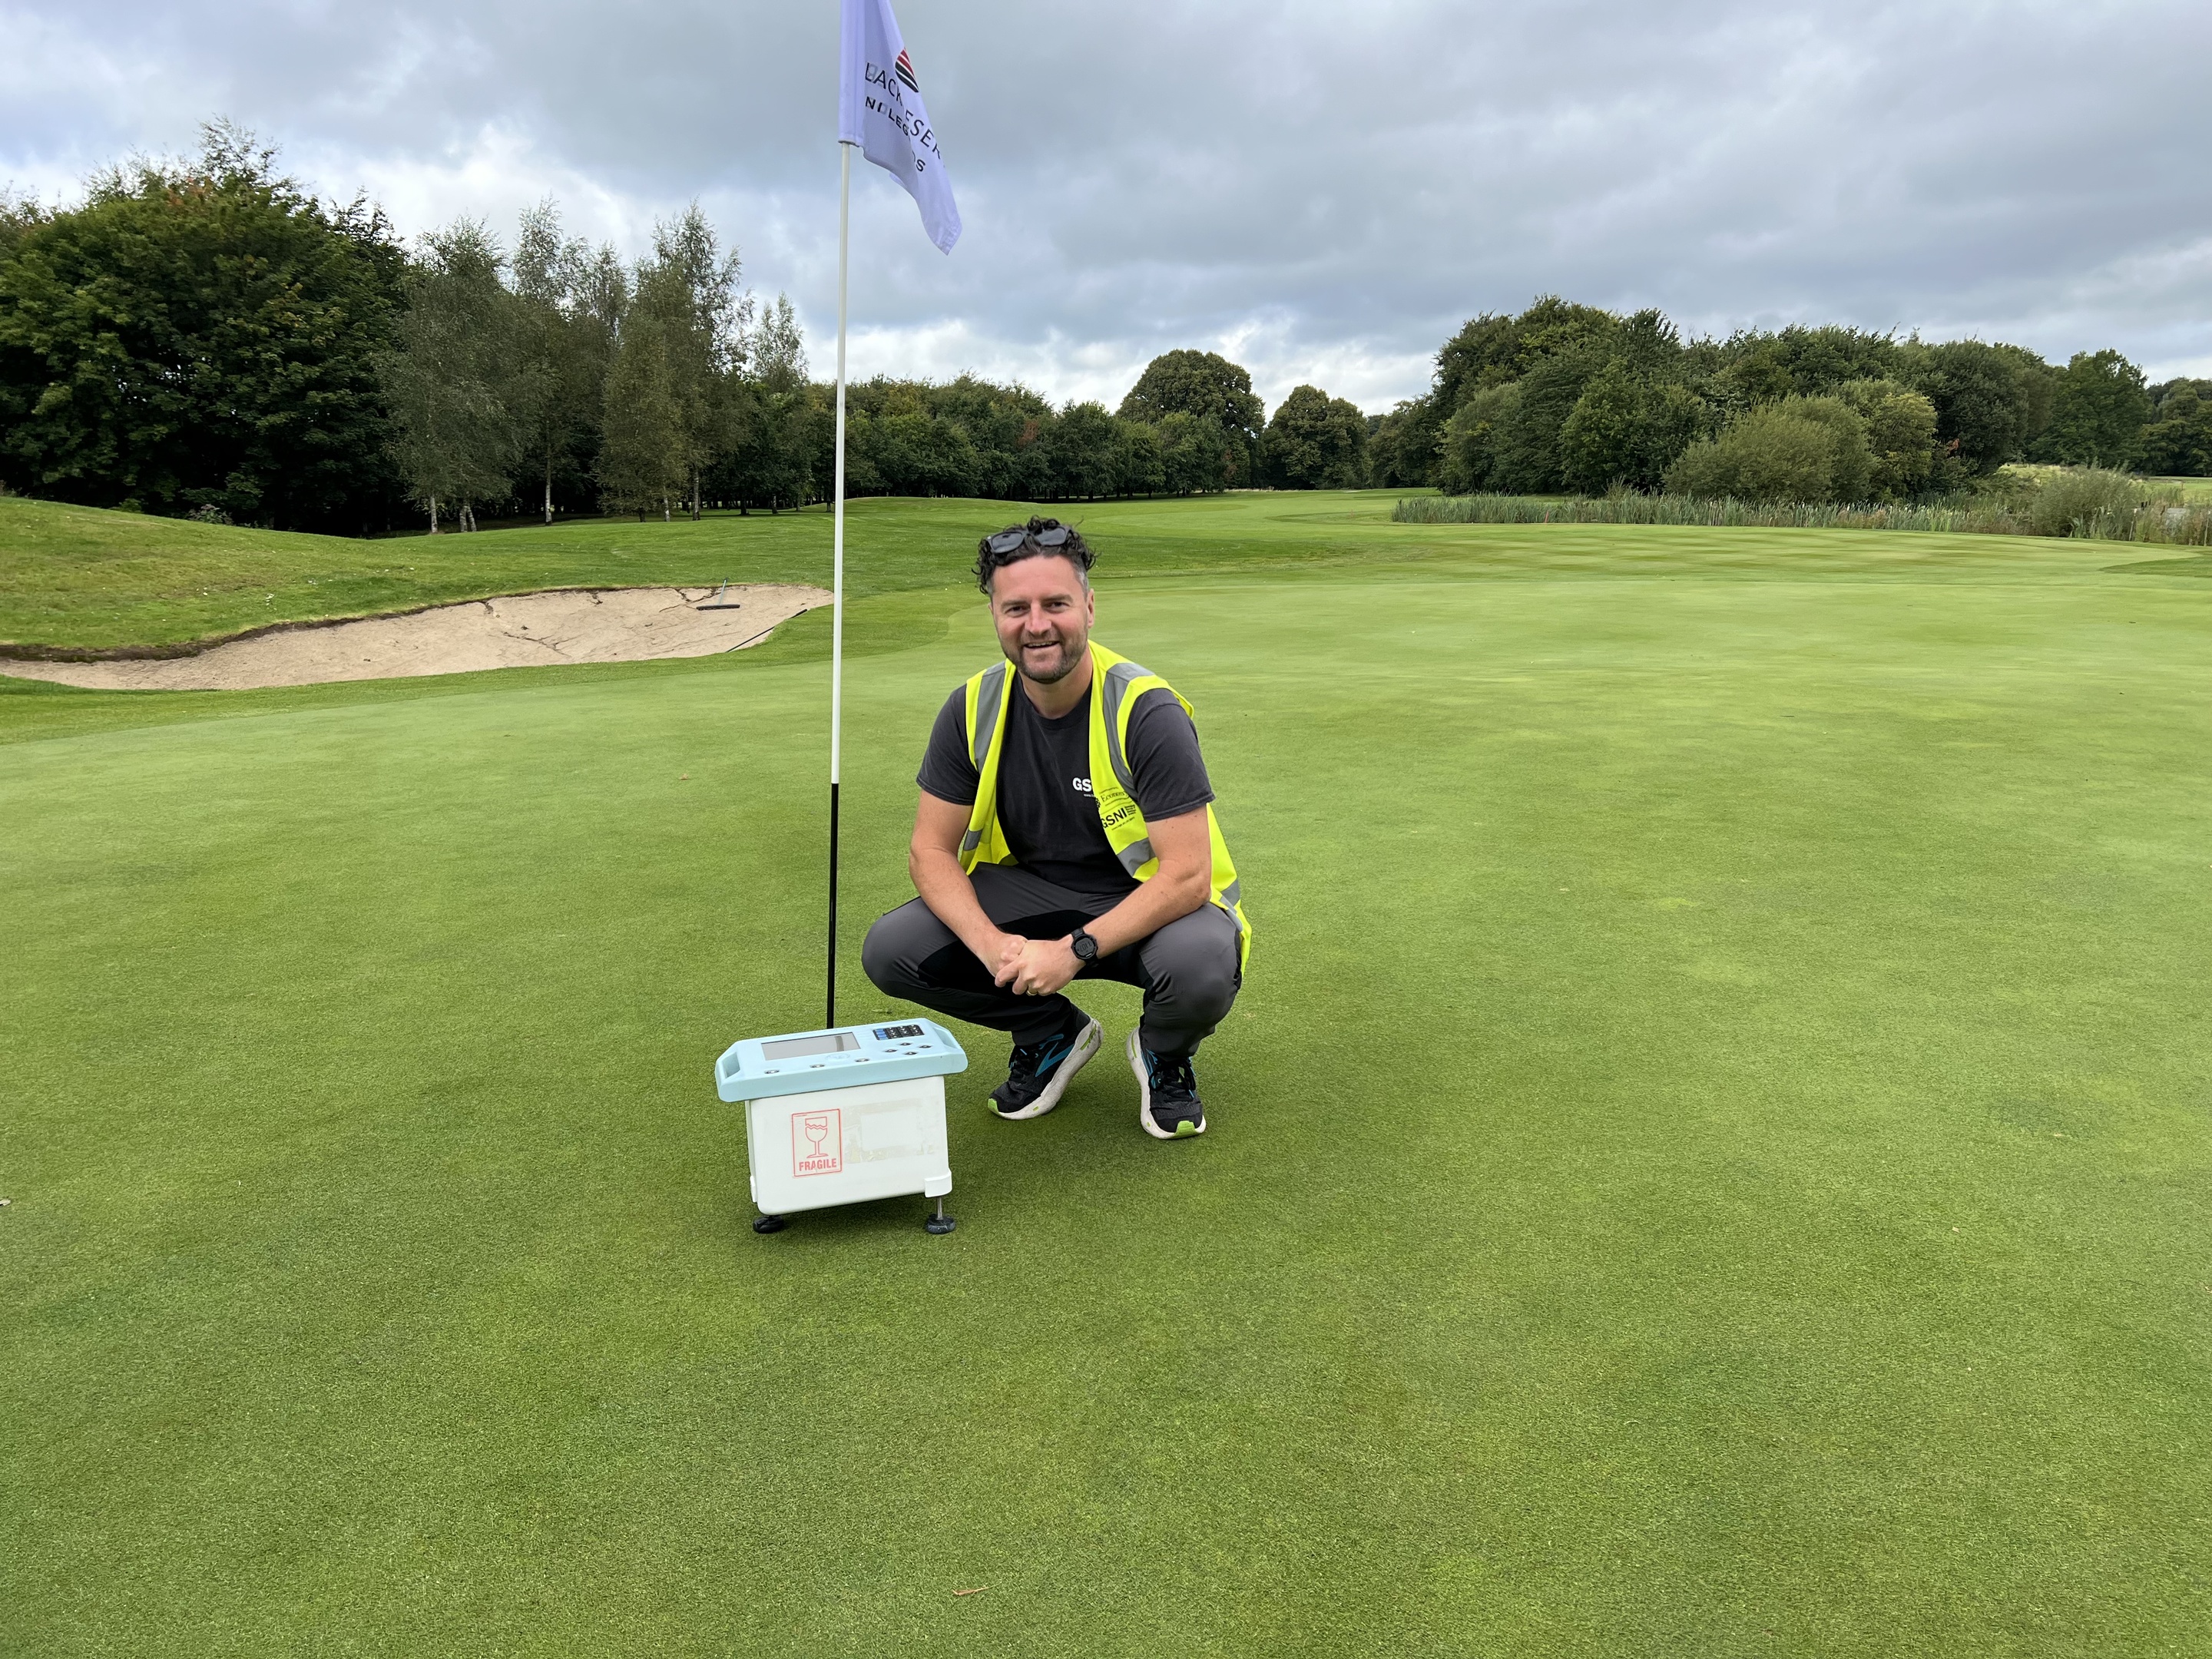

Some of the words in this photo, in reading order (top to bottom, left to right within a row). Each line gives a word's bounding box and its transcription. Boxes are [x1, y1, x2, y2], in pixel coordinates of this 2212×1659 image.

[865, 62, 902, 106] LACK
[1072, 777, 1091, 792] GS
[1101, 808, 1127, 828] GSNI
[799, 1158, 837, 1171] FRAGILE
